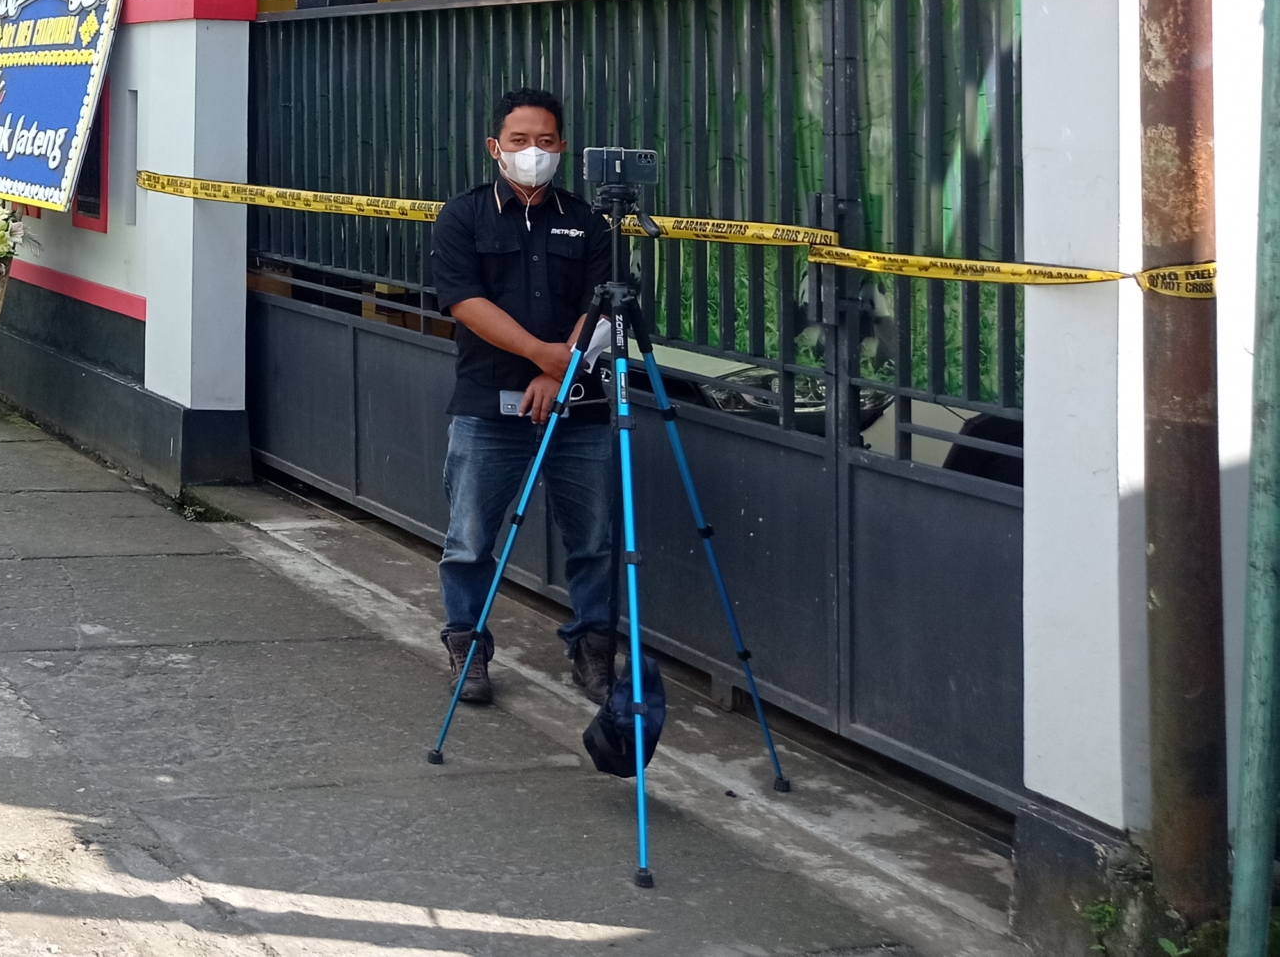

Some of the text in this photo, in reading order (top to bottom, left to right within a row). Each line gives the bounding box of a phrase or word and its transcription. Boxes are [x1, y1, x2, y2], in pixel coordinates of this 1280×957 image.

[6, 114, 68, 170] Jateng
[672, 219, 749, 236] DILARANG MELINTAS
[772, 227, 834, 245] GARIS POLISI
[1160, 281, 1182, 291] NOT
[1185, 282, 1213, 293] CROSS
[615, 314, 625, 346] ZOMEI
